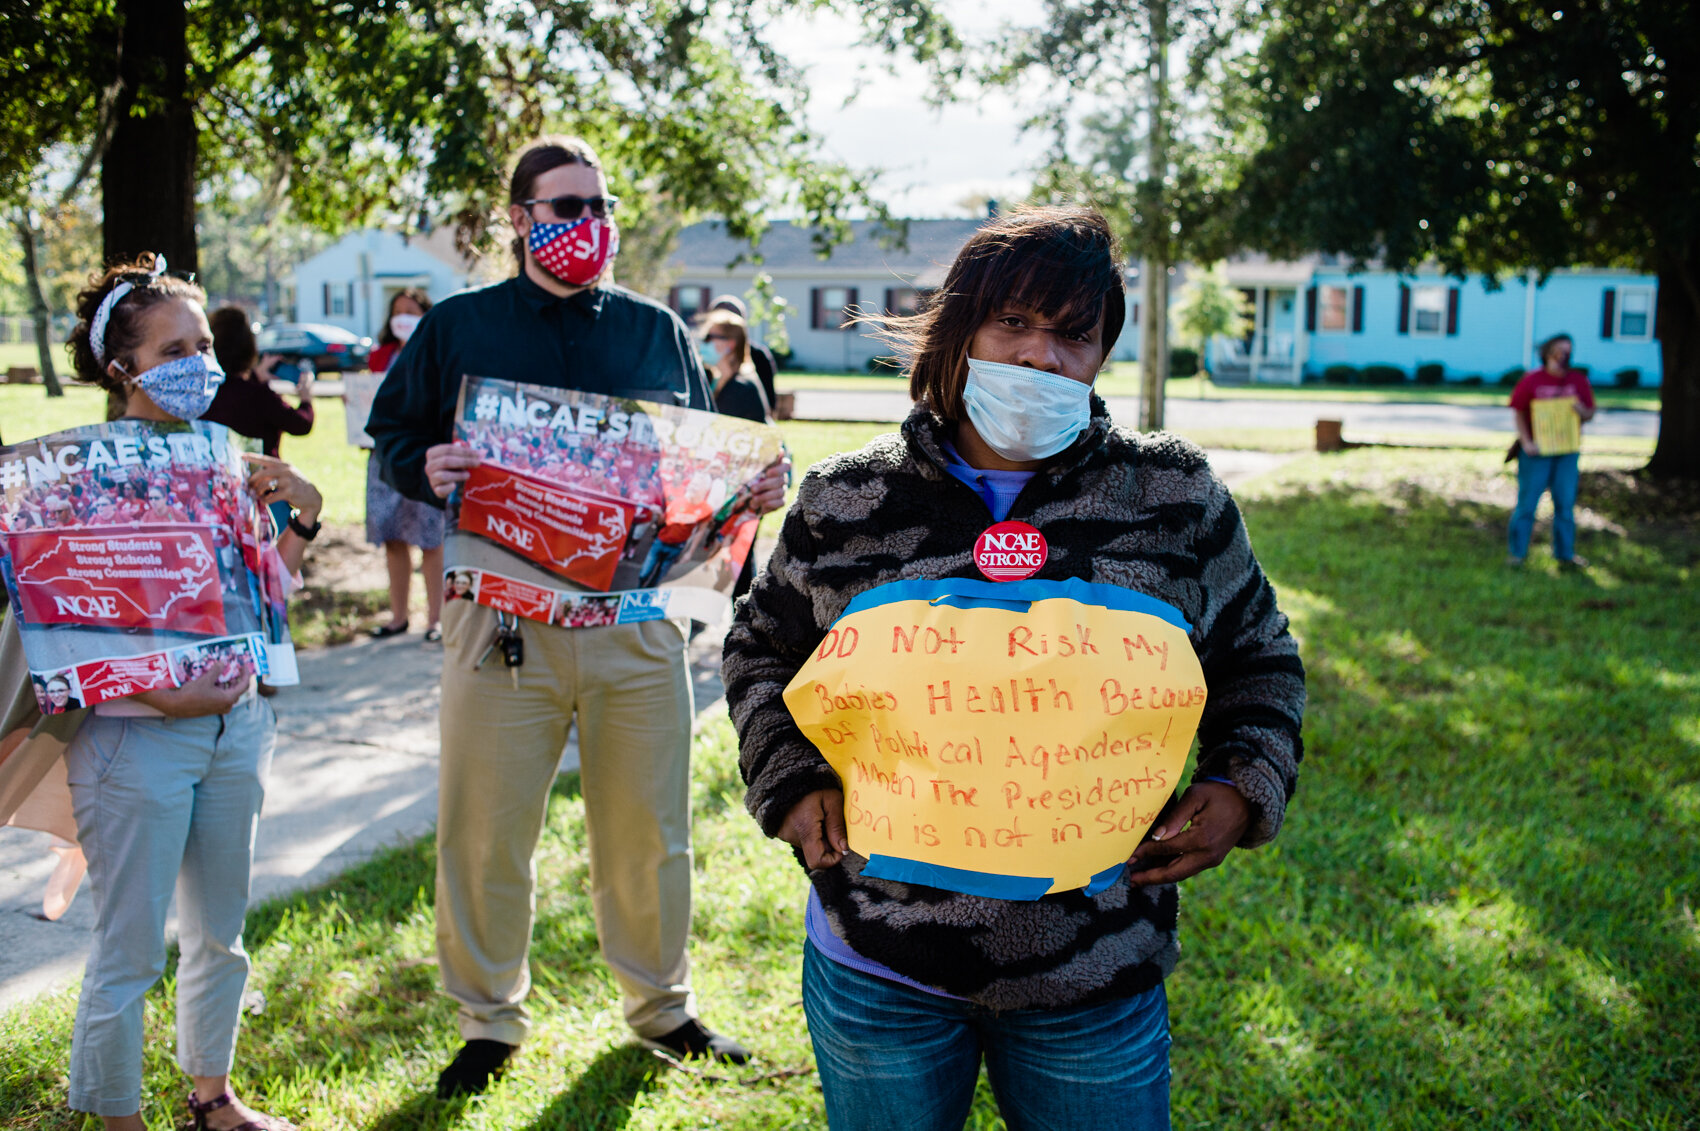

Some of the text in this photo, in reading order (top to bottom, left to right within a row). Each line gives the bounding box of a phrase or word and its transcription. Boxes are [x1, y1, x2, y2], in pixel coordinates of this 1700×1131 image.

[487, 514, 535, 551] NCAE
[983, 532, 1041, 551] NCAE
[68, 540, 163, 554] Strong Students
[76, 554, 163, 568] Strong Schools
[979, 552, 1042, 566] STRONG
[66, 567, 182, 580] Strong Communities
[53, 595, 120, 618] NCAE
[1008, 624, 1100, 657] Risk
[1123, 634, 1168, 671] My
[815, 683, 898, 715] Babies
[927, 679, 1073, 715] Health
[852, 757, 916, 799] When
[1001, 766, 1167, 810] Presidents
[913, 814, 941, 847] is
[964, 816, 1033, 849] not
[1051, 817, 1083, 845] in
